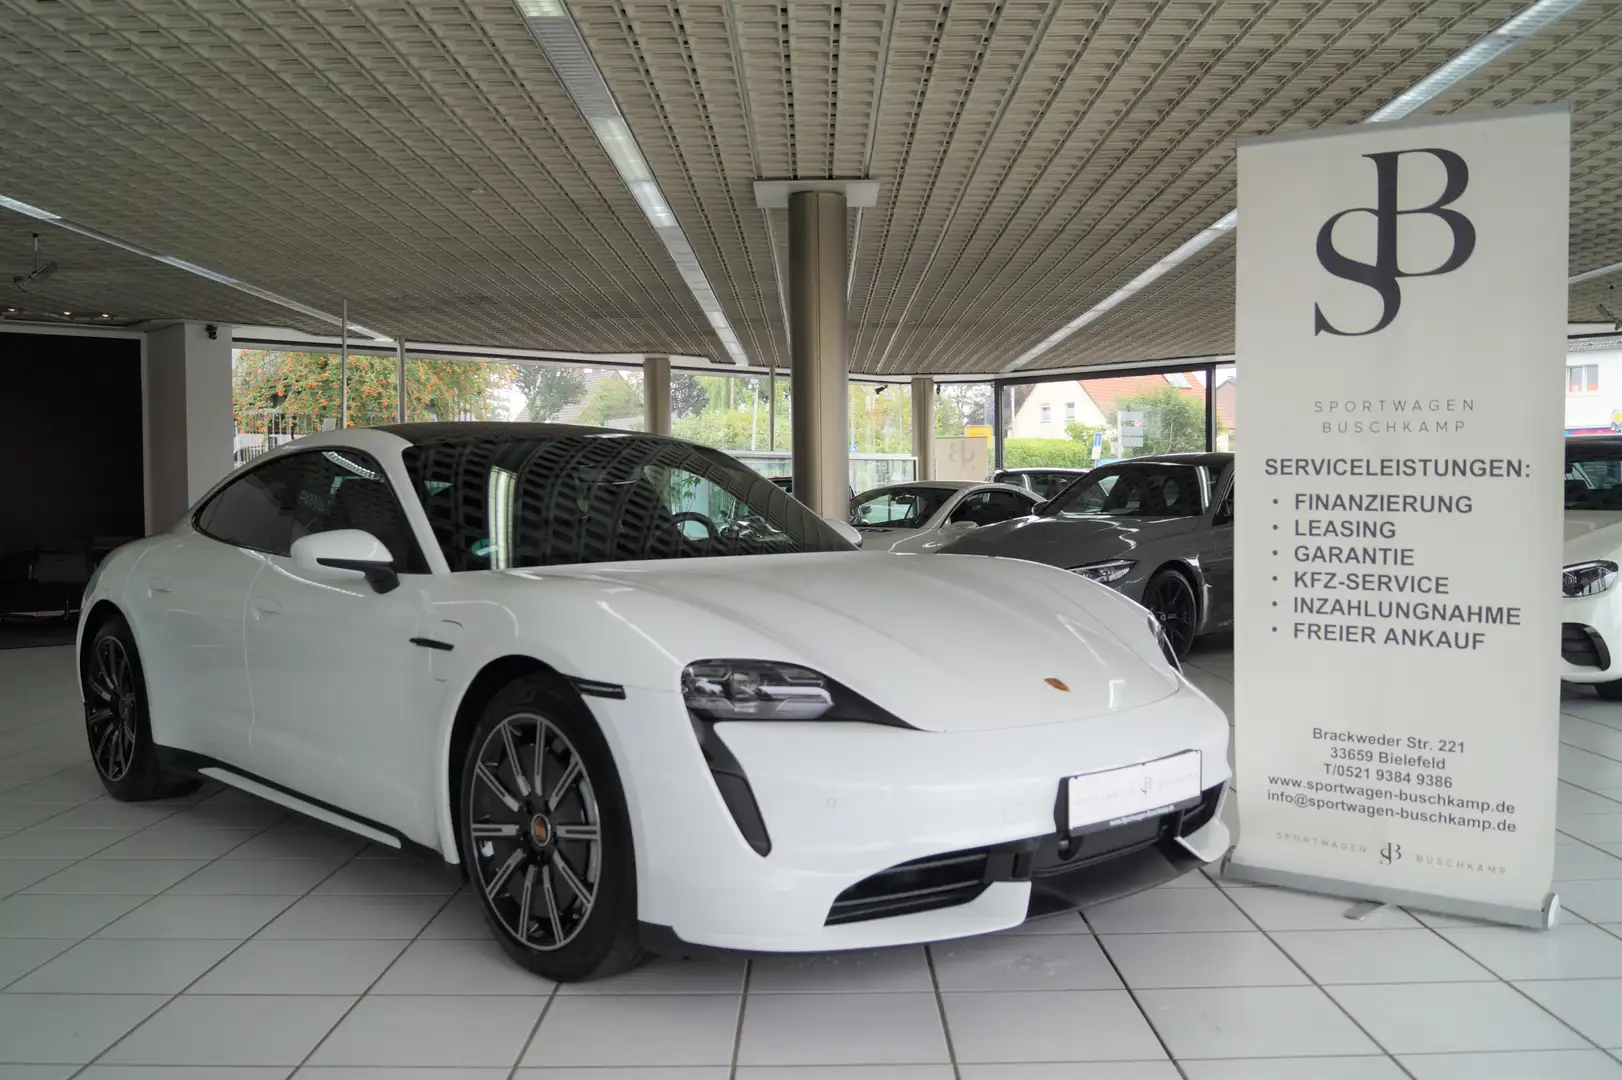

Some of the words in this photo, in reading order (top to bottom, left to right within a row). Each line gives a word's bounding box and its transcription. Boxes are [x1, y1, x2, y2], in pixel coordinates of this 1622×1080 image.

[1314, 398, 1474, 413] SPORTWAGEN
[1322, 420, 1466, 434] BUSCHKAMP
[1265, 458, 1530, 478] SERVICELEISTUNGEN:
[1295, 493, 1473, 514] FINANZIERUNG
[1295, 519, 1396, 540] LEASING
[1294, 545, 1415, 566] GARANTIE
[1294, 571, 1450, 595] KFZ-SERVICE
[1294, 597, 1521, 626] INZAHLUNGNAHME
[1294, 622, 1376, 645] FREIER
[1384, 627, 1486, 651] ANKAUF
[1312, 728, 1402, 748] Brackweder
[1406, 736, 1433, 751] Str.
[1438, 740, 1465, 753] 221
[1331, 747, 1373, 762] 33659
[1378, 751, 1446, 770] Bielefeld
[1324, 763, 1370, 780] T/0521
[1376, 769, 1412, 784] 9384
[1416, 773, 1453, 788] 9386
[1268, 775, 1516, 814] www.sportwagen-buschkamp.de
[1267, 789, 1517, 833] info@sportwagen-buschkamp.de
[1276, 832, 1368, 853] SPORTWAGEN
[1416, 855, 1507, 874] BUSCHKAMP
